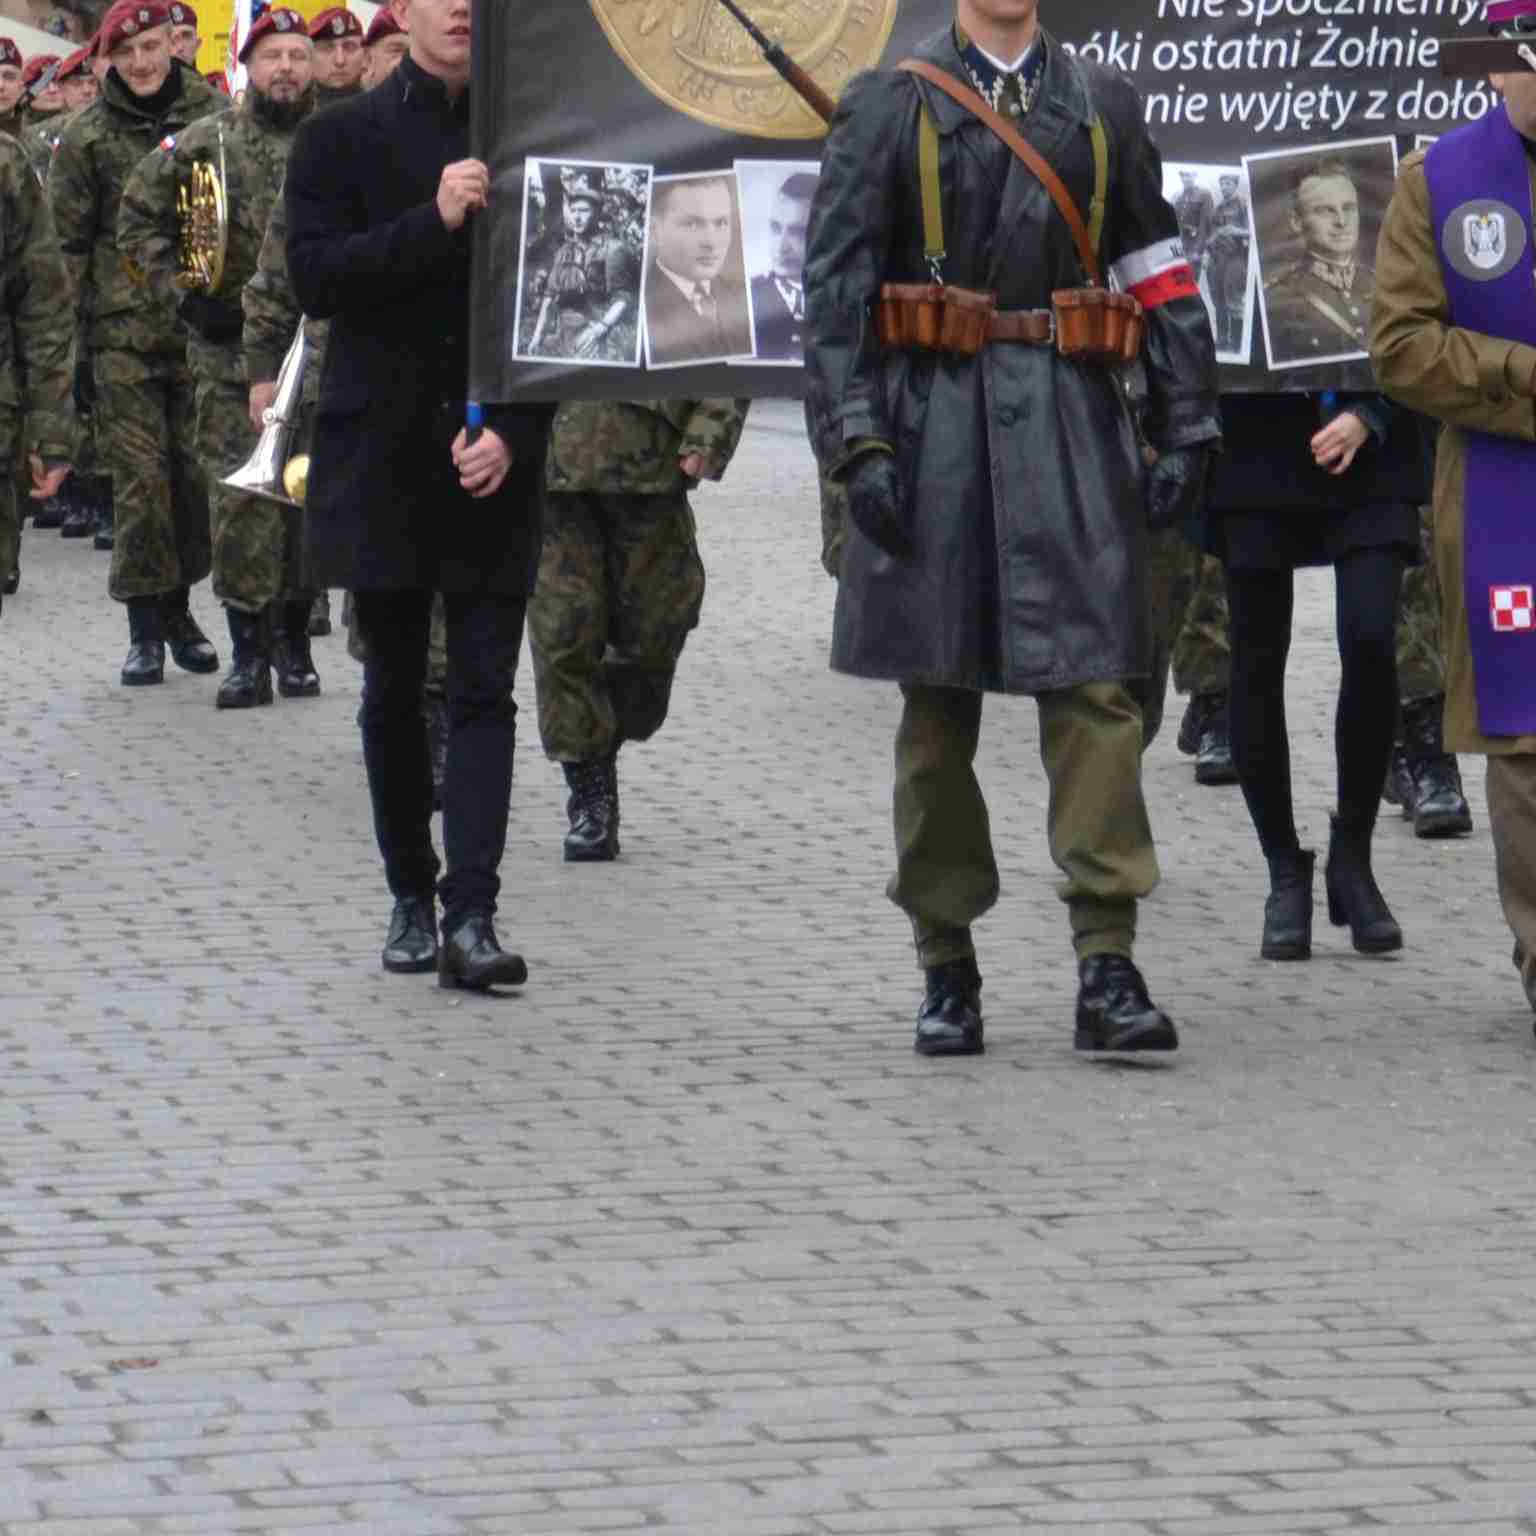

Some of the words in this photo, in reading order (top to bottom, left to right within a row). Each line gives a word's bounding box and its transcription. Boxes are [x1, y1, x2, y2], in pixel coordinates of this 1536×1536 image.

[1152, 28, 1303, 71] ostatni
[1309, 20, 1440, 68] Żołnie
[1144, 83, 1208, 124] nie
[1219, 81, 1358, 133] wyjęty
[1363, 90, 1389, 120] z
